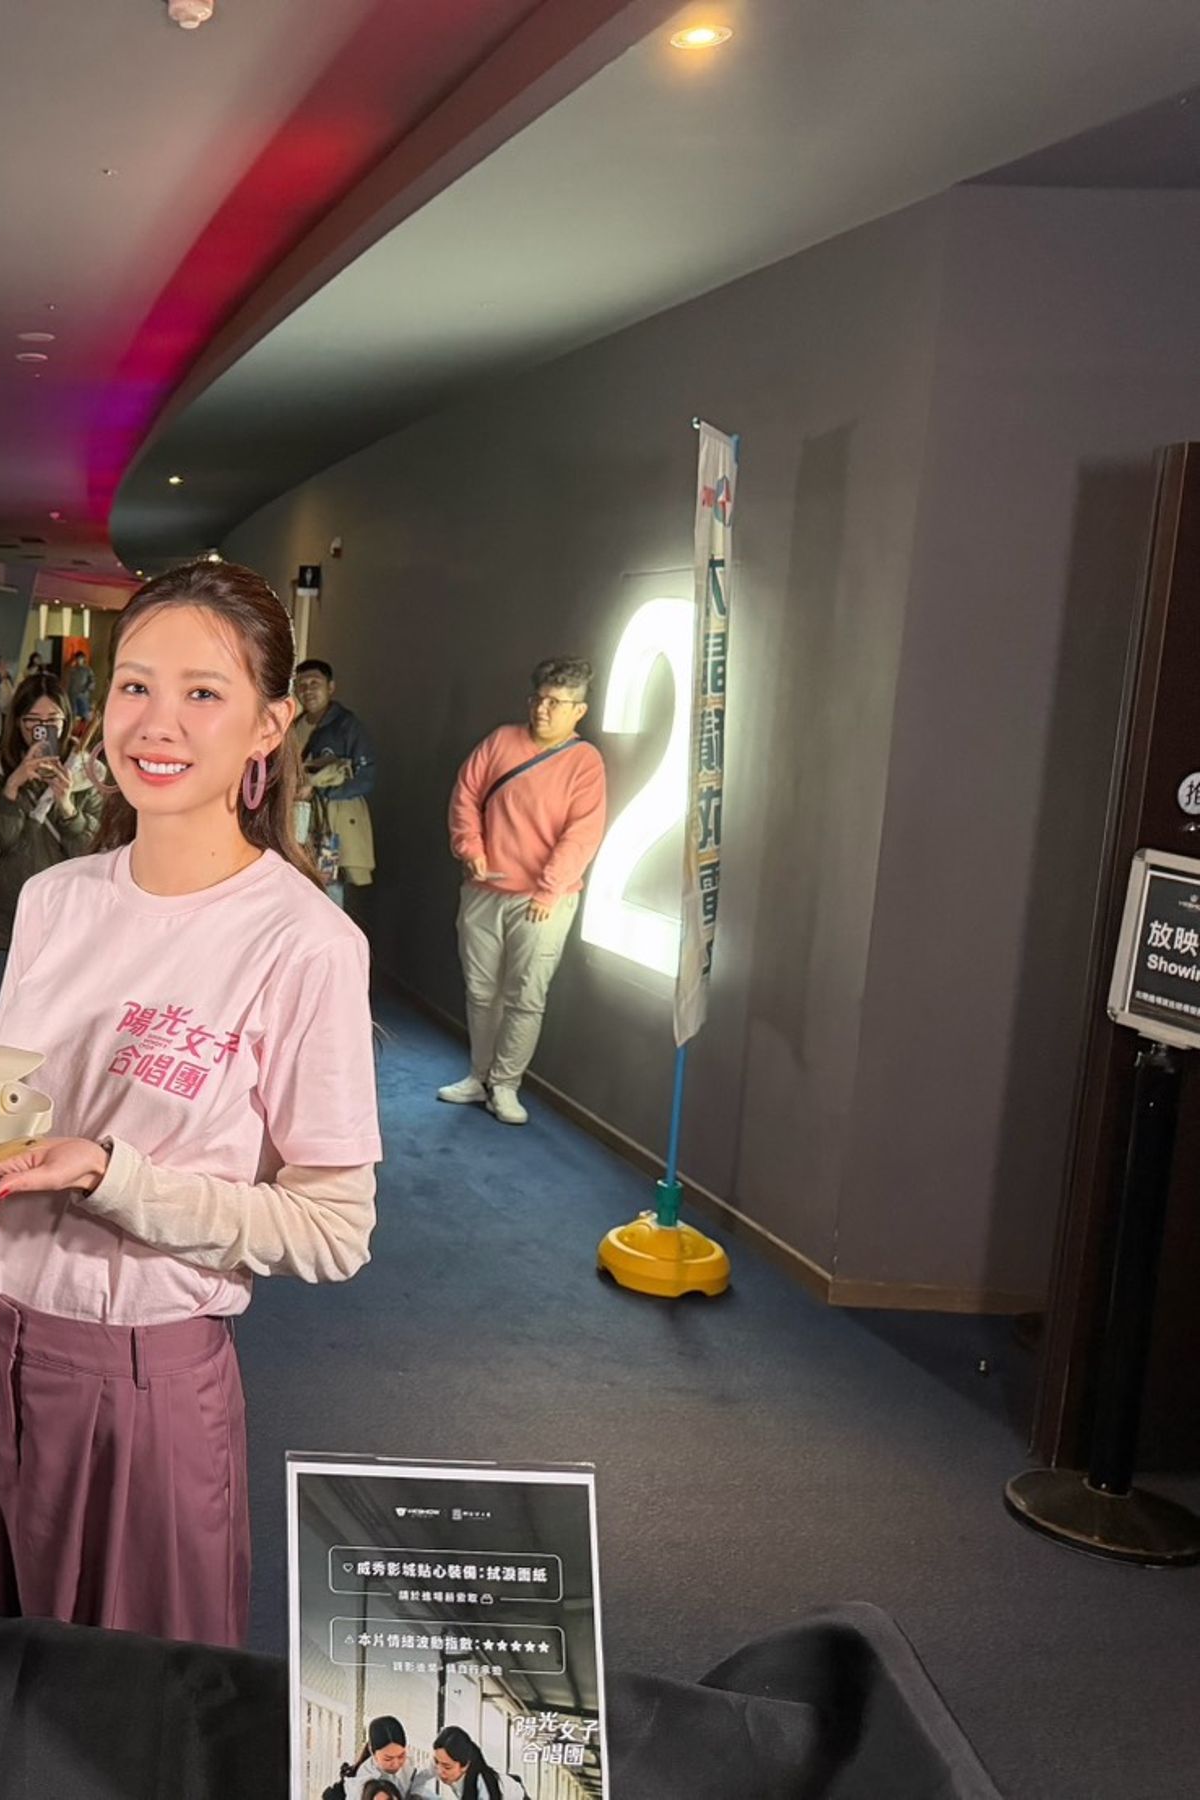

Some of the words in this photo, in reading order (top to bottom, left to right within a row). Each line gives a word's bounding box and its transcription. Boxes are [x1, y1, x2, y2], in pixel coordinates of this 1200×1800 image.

[581, 597, 695, 978] 2
[1147, 920, 1199, 957] 放映
[115, 1001, 241, 1064] 陽光女子
[107, 1044, 211, 1101] 合唱團
[512, 1711, 598, 1741] 陽光女子
[522, 1742, 584, 1766] 合唱團
